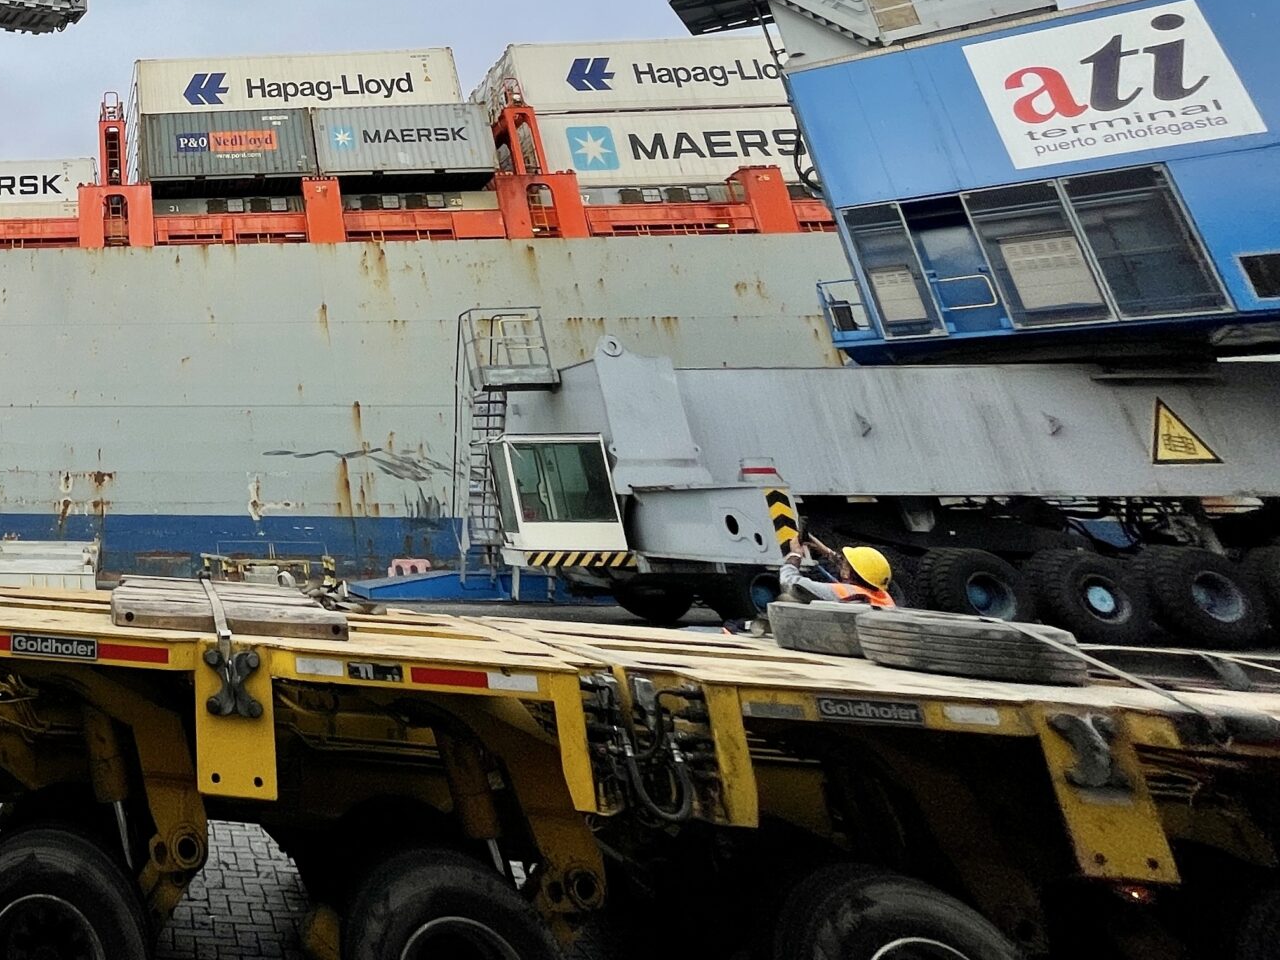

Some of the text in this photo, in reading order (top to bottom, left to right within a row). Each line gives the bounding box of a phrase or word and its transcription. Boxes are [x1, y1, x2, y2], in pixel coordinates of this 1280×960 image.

[632, 58, 782, 88] Hapag-Llo
[1004, 12, 1210, 124] ati
[246, 70, 414, 102] Hapag-Lloyd
[361, 126, 468, 144] MAERSK
[1024, 98, 1223, 143] terminal
[179, 137, 208, 148] P&O
[628, 129, 807, 160] MAERS
[1033, 115, 1229, 157] puerto antofagasta
[14, 636, 94, 656] Goldhofer
[821, 699, 918, 721] Goldhofer
